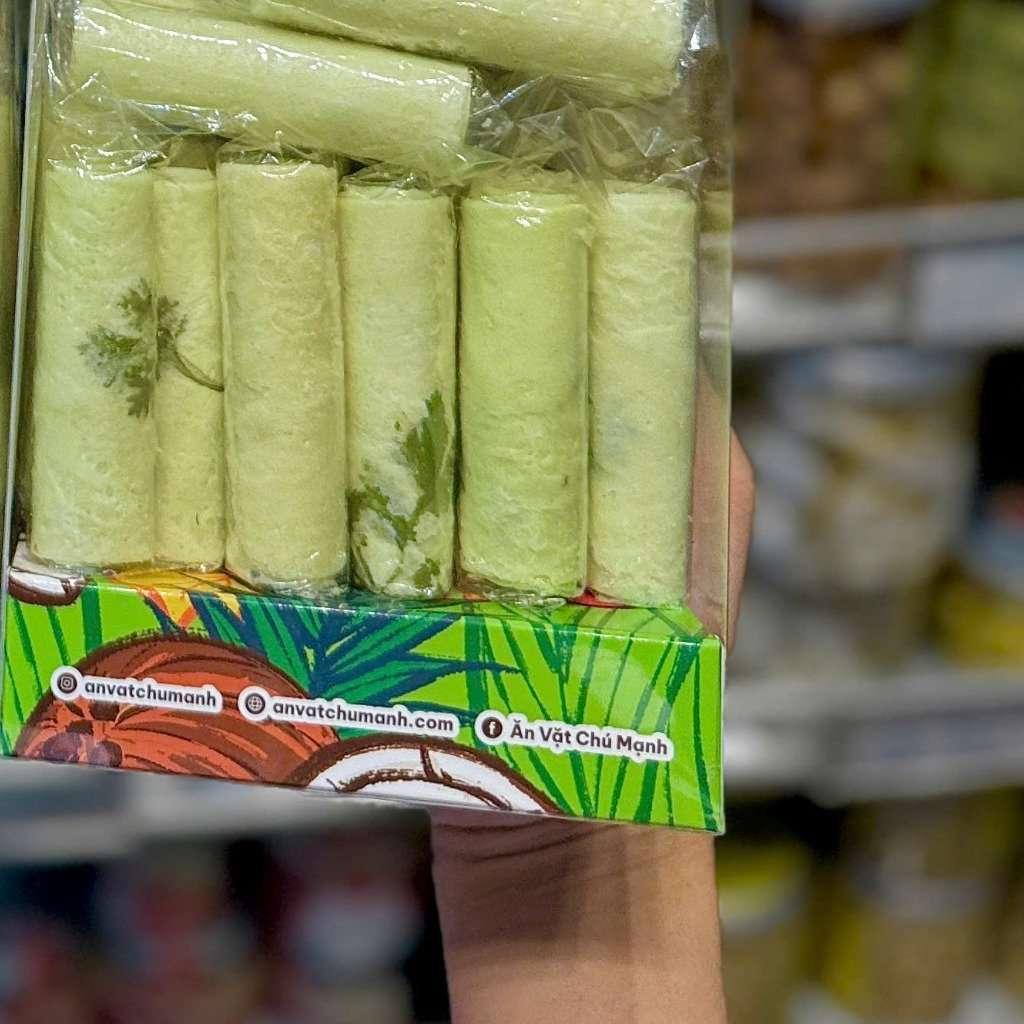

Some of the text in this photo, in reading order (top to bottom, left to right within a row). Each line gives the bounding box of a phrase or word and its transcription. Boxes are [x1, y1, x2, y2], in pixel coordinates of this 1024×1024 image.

[84, 681, 217, 707] anvatchumanh
[272, 702, 454, 732] anvatchumanh.com
[510, 719, 668, 757] Ăn Vặt Chú Mạnh
